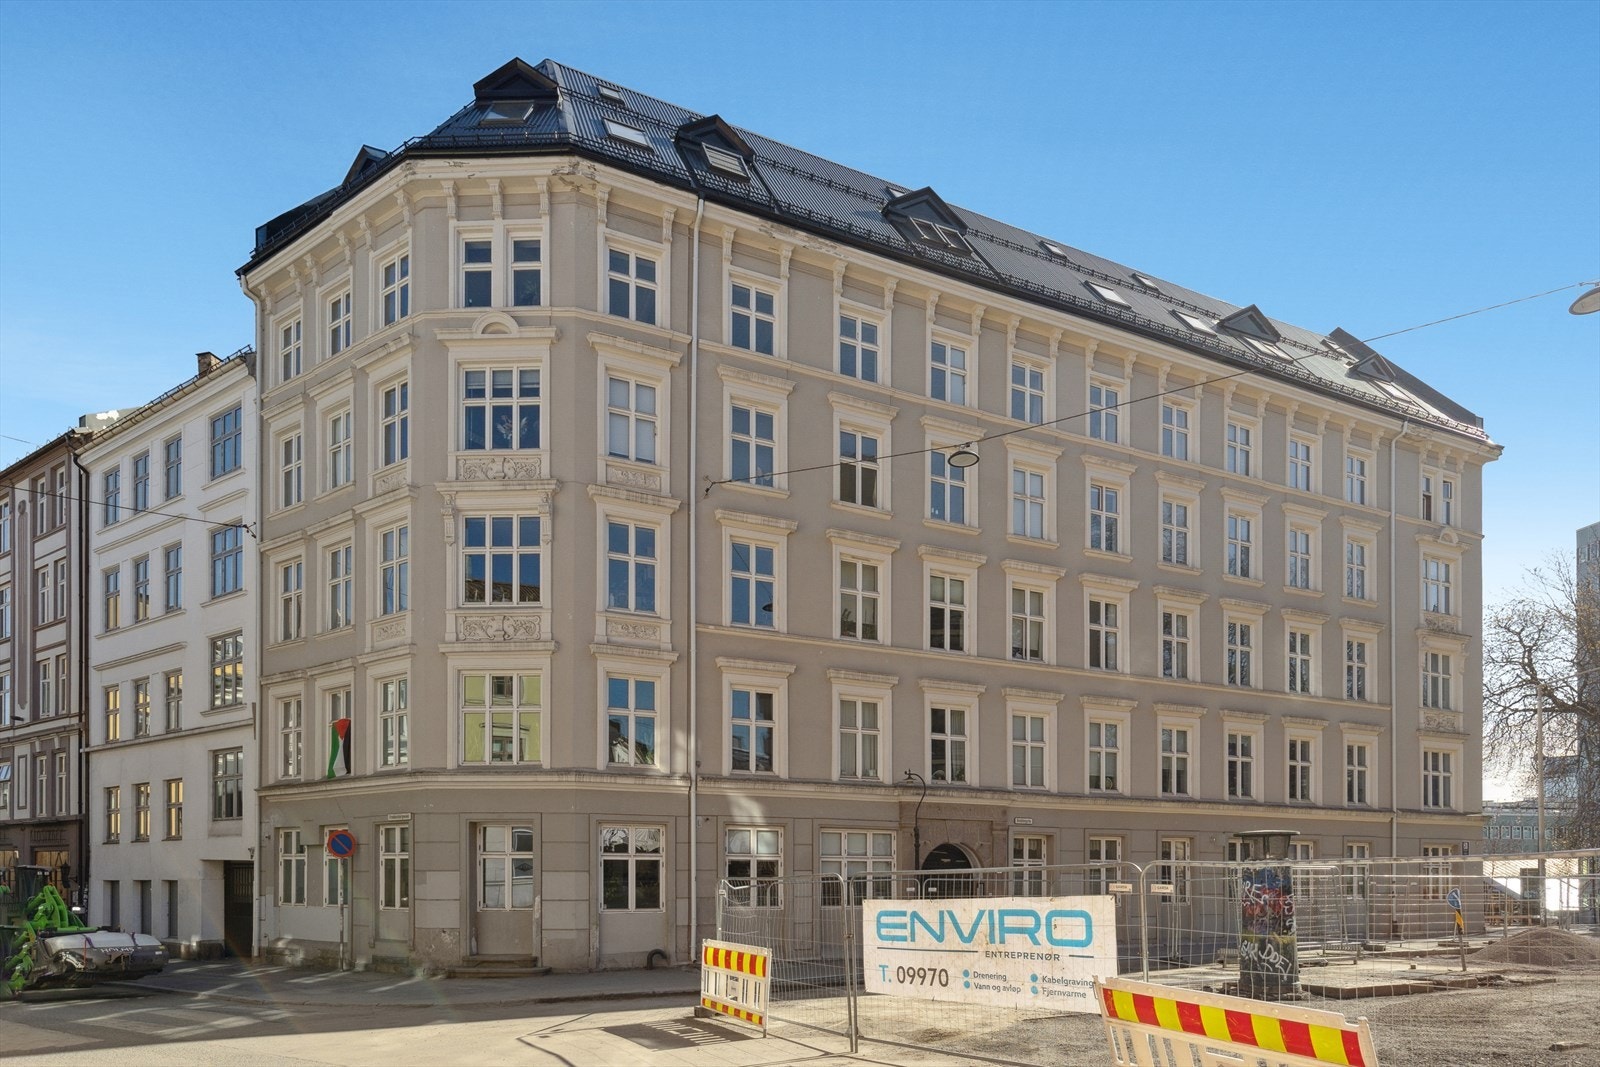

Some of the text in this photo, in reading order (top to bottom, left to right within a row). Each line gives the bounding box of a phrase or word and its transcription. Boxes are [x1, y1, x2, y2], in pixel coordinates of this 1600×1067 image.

[876, 909, 1093, 948] ENVIRO
[985, 951, 1060, 962] ENTREPRENØR
[878, 964, 949, 987] T. 09970
[973, 971, 1007, 982] Drenering
[974, 982, 991, 990] Vann
[1002, 985, 1022, 994] avløp
[1042, 975, 1094, 989] Kabelgraving
[1042, 987, 1087, 998] Fjernvarme
